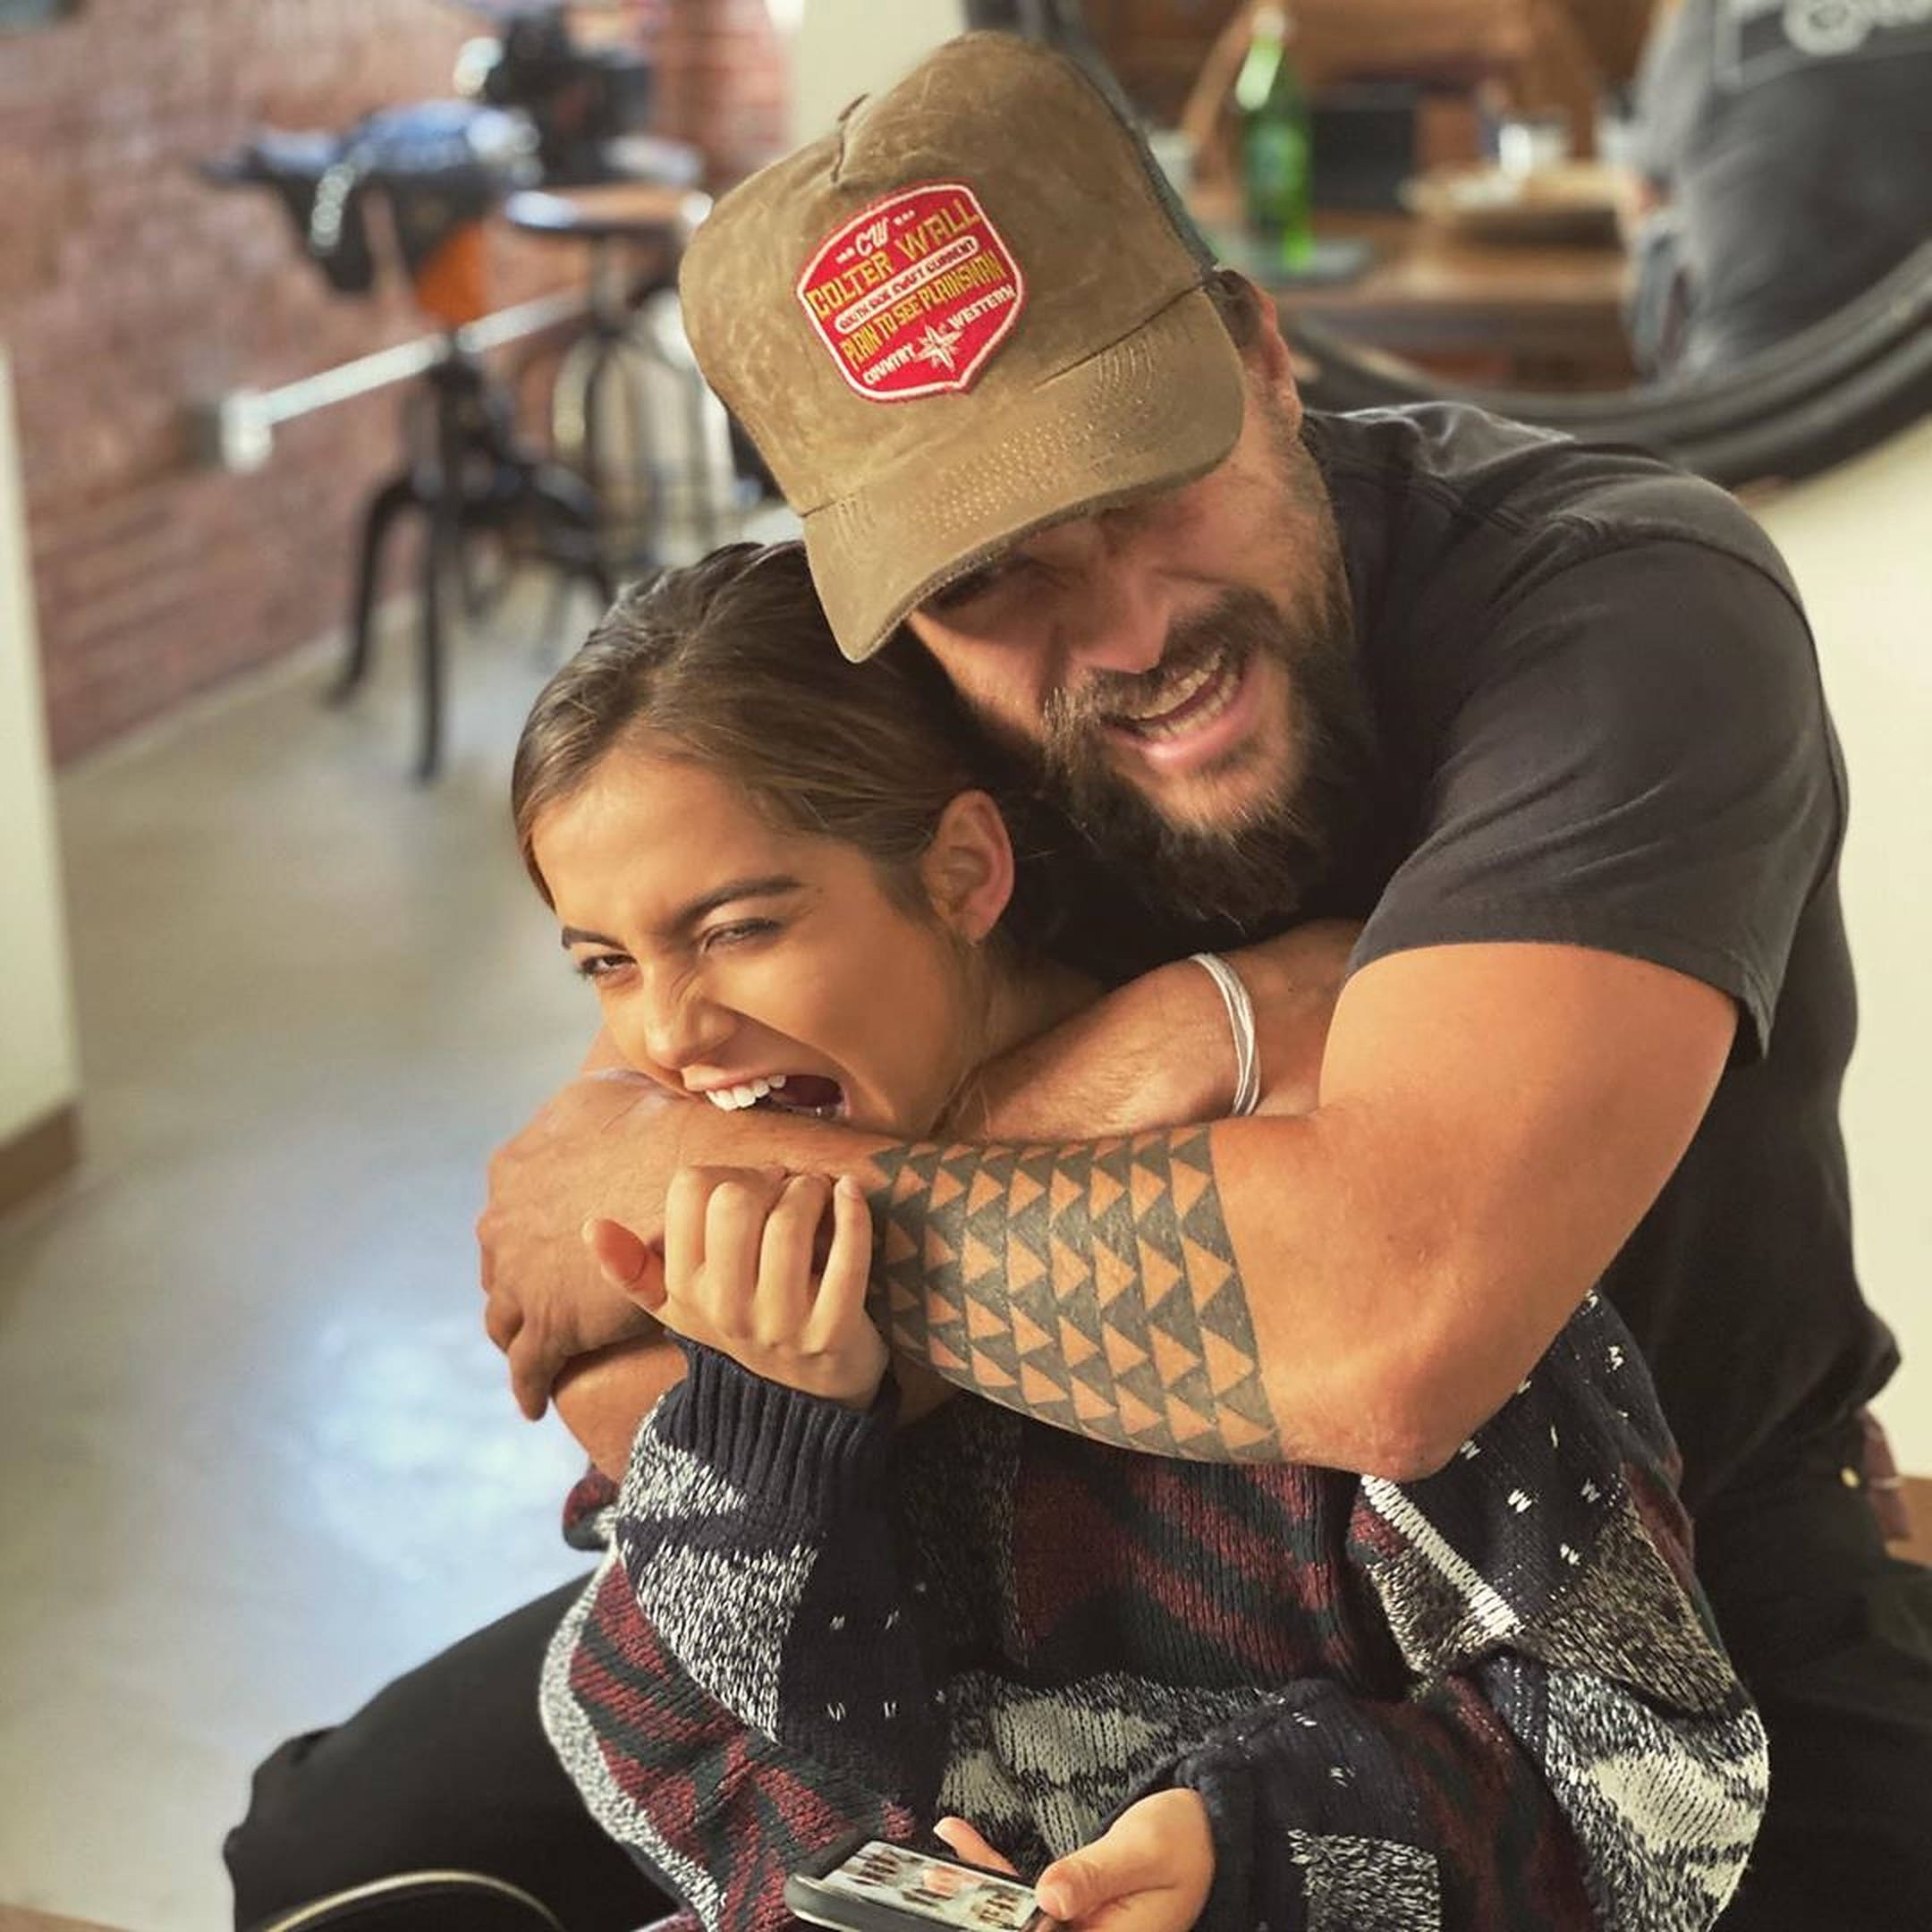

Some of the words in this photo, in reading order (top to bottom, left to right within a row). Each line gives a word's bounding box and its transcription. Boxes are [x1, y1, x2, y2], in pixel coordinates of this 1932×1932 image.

[806, 250, 894, 318] COLTER
[894, 198, 982, 261] WALL
[839, 319, 885, 372] PLAIN
[873, 312, 899, 340] TO
[893, 294, 925, 327] SEE
[917, 249, 1007, 311] PLAINSMAN
[946, 283, 1018, 331] WESTERN
